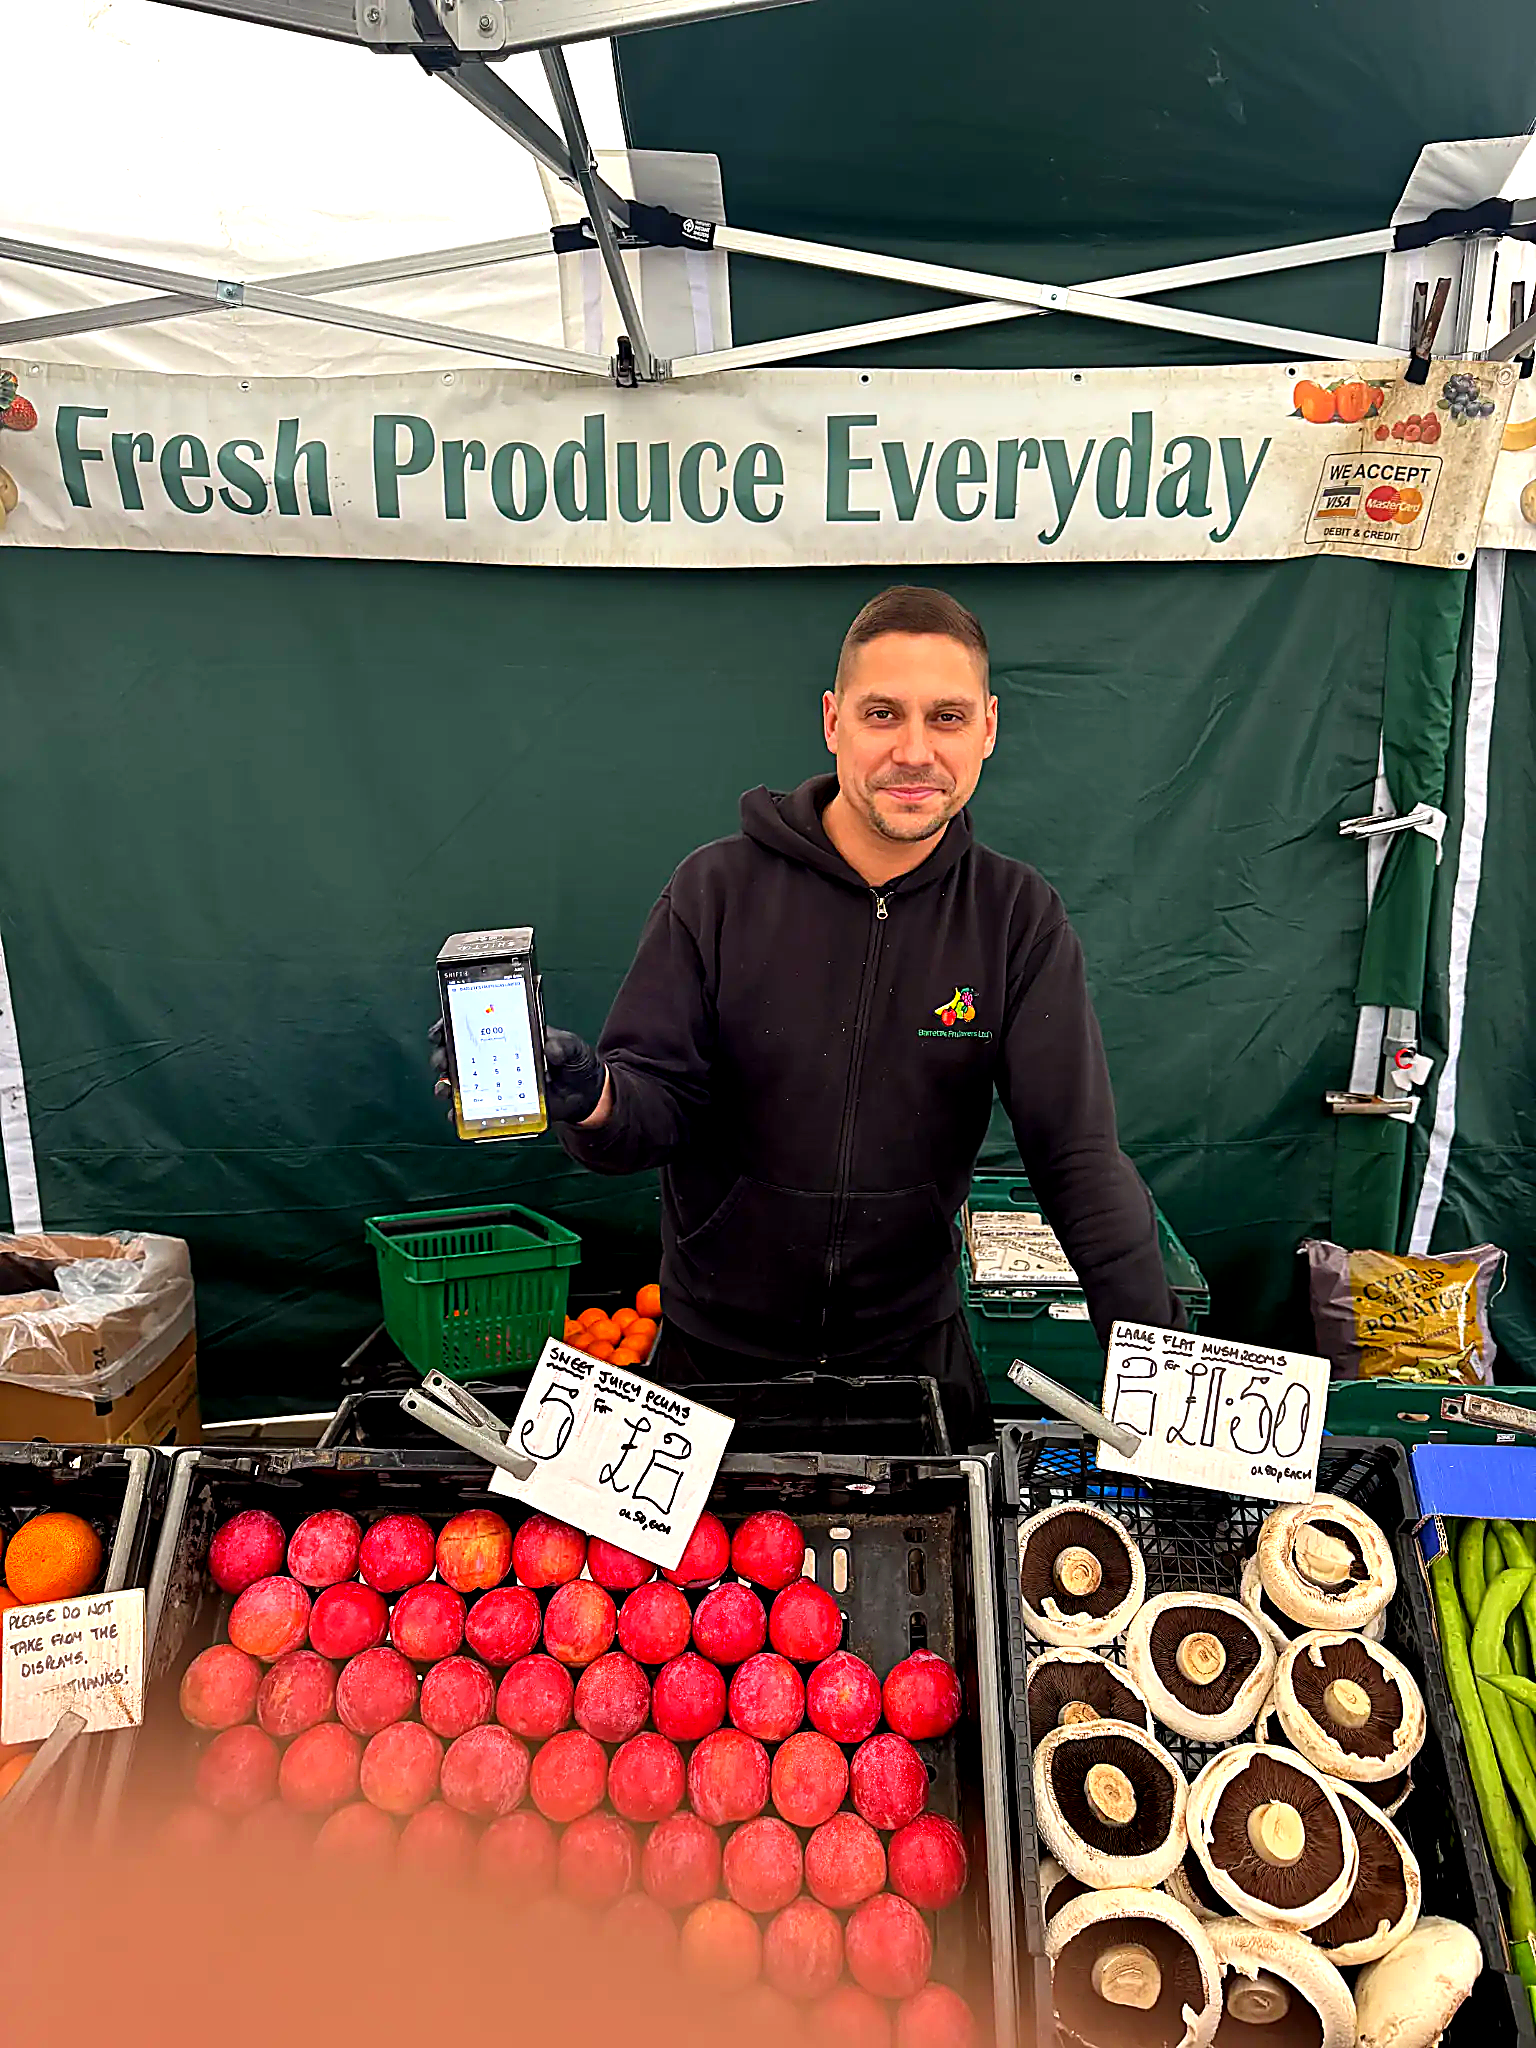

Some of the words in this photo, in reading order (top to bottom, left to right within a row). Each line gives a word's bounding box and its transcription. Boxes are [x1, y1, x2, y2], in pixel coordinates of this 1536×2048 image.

[56, 405, 334, 517] Fresh
[373, 414, 785, 523] Produce
[827, 410, 1272, 544] Everyday
[1330, 464, 1352, 481] WE
[1353, 463, 1431, 484] ACCEPT
[1326, 496, 1351, 508] VISA
[1367, 498, 1420, 513] MasterCard
[1323, 527, 1352, 537] DEBIT
[1353, 529, 1361, 538] &
[1363, 529, 1400, 541] CREDIT
[514, 1052, 520, 1060] 3
[1116, 1326, 1156, 1345] LARGE
[1162, 1334, 1196, 1352] FLAT
[1201, 1342, 1288, 1367] MUSHROOMS
[599, 1370, 642, 1397] JUICY
[1112, 1356, 1158, 1437] 2
[1166, 1362, 1311, 1458] £1.50
[520, 1382, 580, 1461] 5
[599, 1416, 692, 1515] £2
[9, 1608, 57, 1631] PLEASE
[62, 1605, 81, 1620] DO
[87, 1599, 114, 1616] NOT
[9, 1637, 44, 1657] TAKE
[51, 1631, 83, 1647] FROM
[90, 1623, 119, 1641] THE
[64, 1665, 128, 1691] THANKS!
